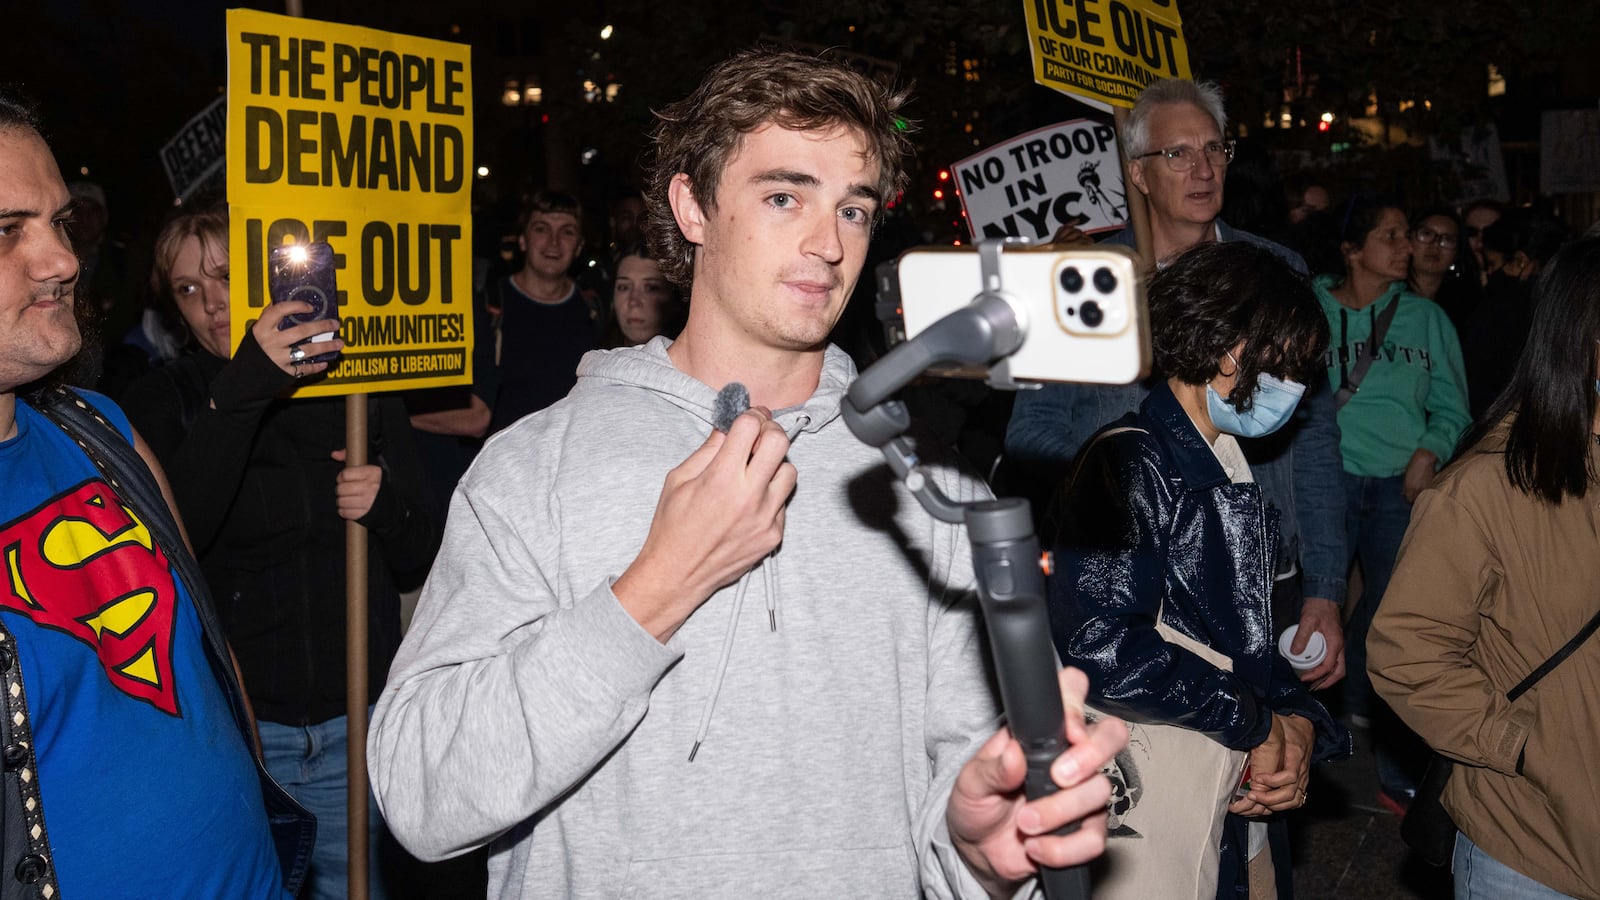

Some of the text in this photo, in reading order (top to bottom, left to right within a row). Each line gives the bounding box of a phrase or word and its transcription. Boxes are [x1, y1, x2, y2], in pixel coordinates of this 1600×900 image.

[1032, 0, 1178, 76] ICE OUT
[1038, 35, 1160, 88] OF OUR COMMU
[240, 31, 465, 116] THE PEOPLE
[1047, 62, 1139, 98] PARTY FOR SOCIALIS
[245, 105, 464, 193] DEMAND
[961, 126, 1114, 196] NO TROOP
[982, 191, 1091, 239] NYC
[1004, 172, 1048, 208] IN
[361, 220, 461, 306] OUT
[390, 357, 399, 374] &
[401, 353, 462, 373] LIBERATION
